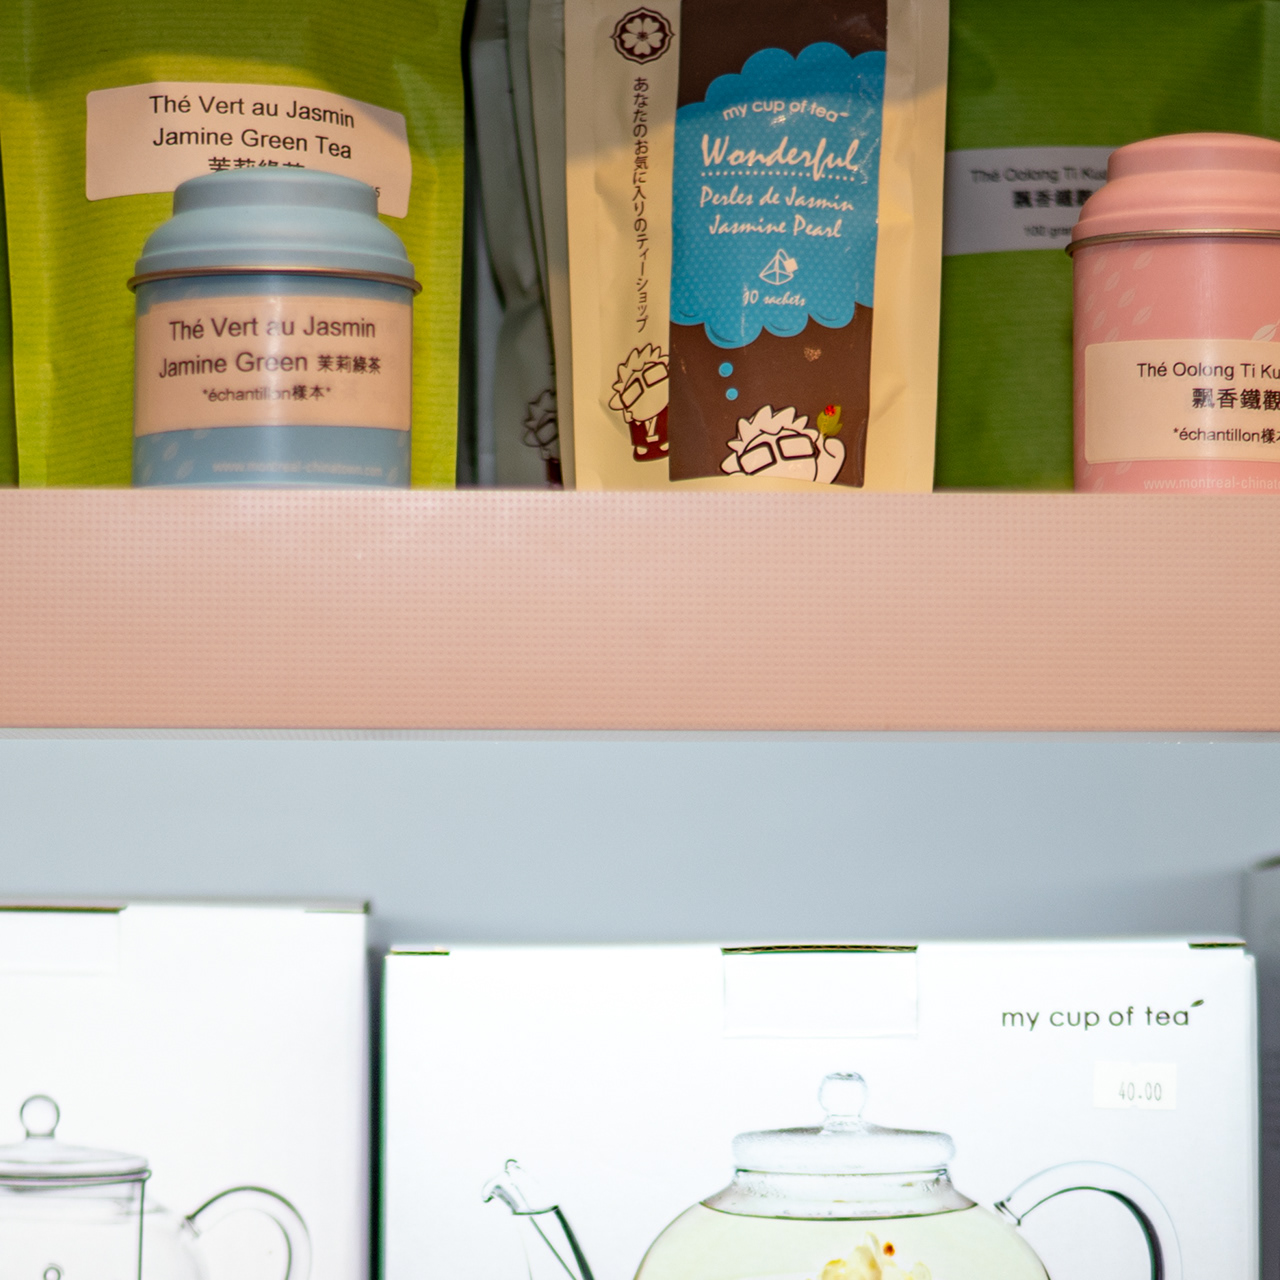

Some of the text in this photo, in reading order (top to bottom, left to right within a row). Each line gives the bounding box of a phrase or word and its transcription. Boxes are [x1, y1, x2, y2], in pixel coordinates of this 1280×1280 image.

[149, 95, 355, 129] Thé Vert au Jasmin
[722, 100, 839, 123] my cup of tea
[153, 127, 352, 159] Jamine Green Tea
[701, 134, 860, 181] Wonderful
[632, 77, 649, 333] あなたのお気に入りのティーショップ
[699, 185, 854, 211] Perles de Jasmin
[709, 214, 842, 238] Jasmine Pearl
[763, 292, 806, 306] sachets
[169, 316, 376, 341] Thé Vert au Jasmin
[159, 351, 308, 379] Jamine Green
[1137, 362, 1167, 378] Thé
[1173, 362, 1234, 380] Oolong
[1240, 363, 1255, 378] Ti
[1002, 1006, 1189, 1032] my cup of tea
[1118, 1081, 1162, 1102] 40.00
